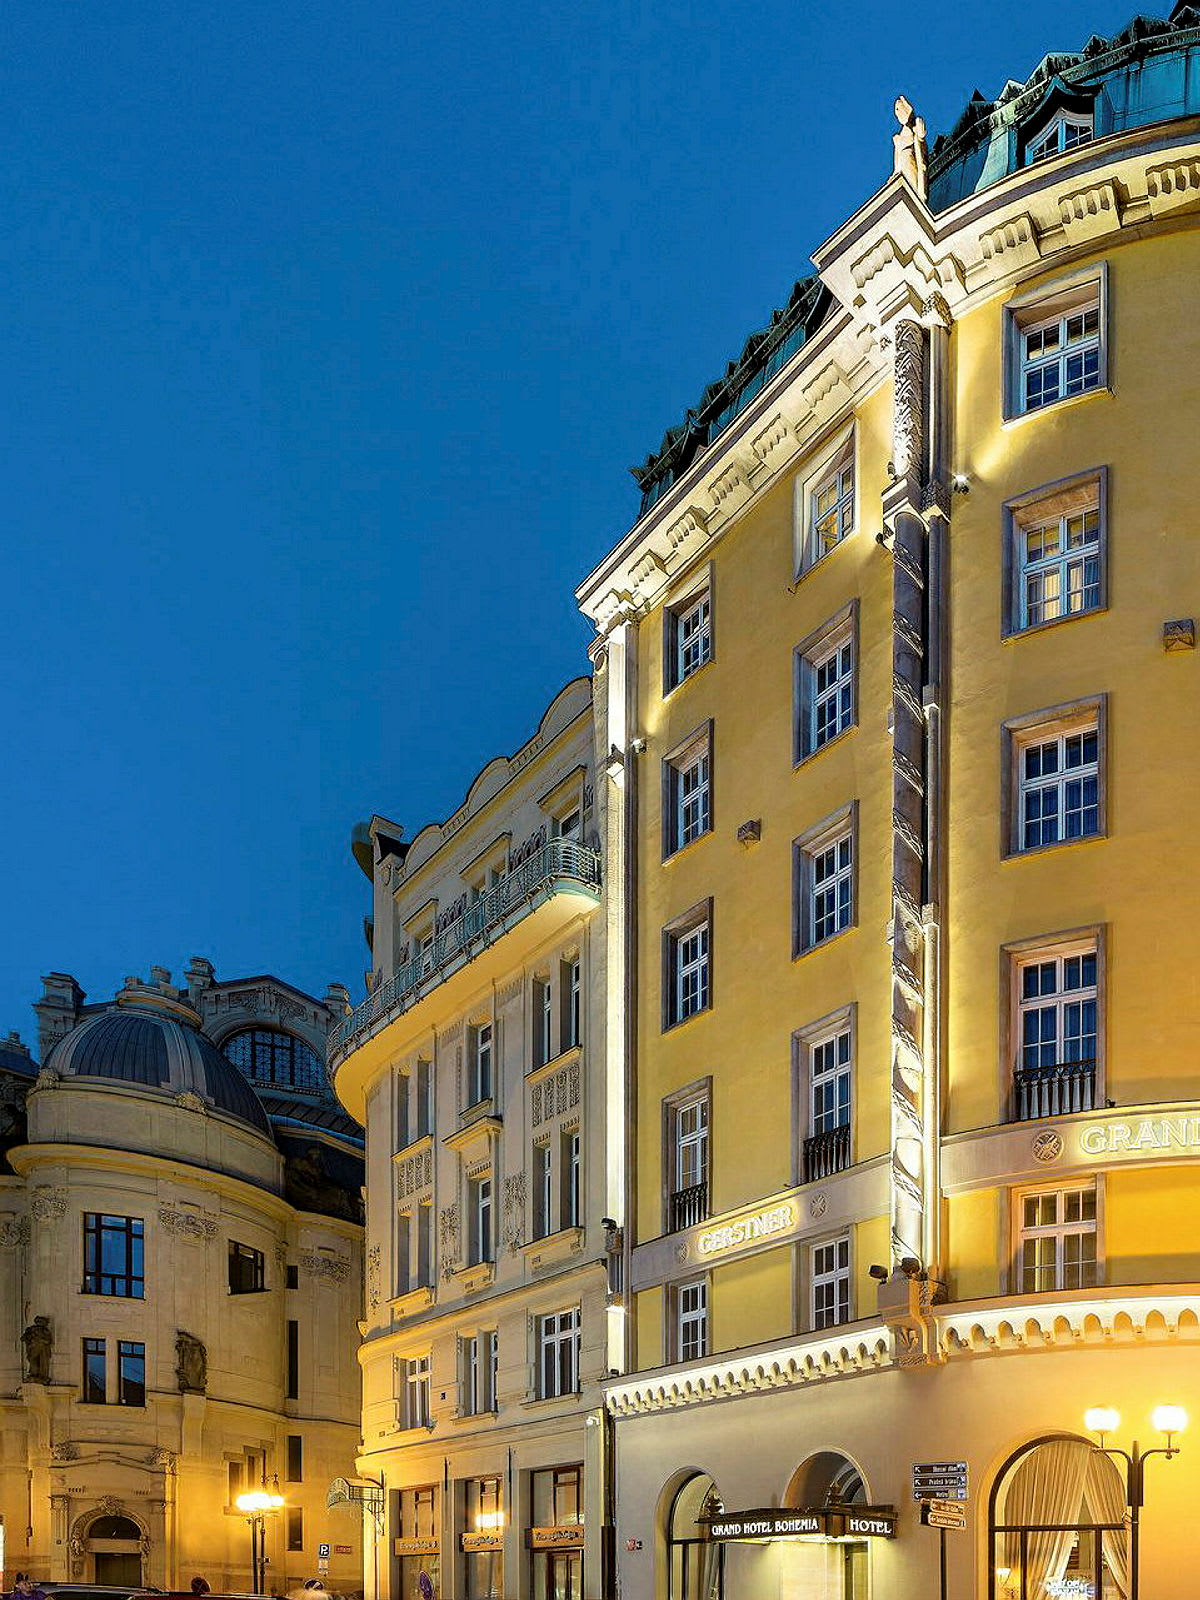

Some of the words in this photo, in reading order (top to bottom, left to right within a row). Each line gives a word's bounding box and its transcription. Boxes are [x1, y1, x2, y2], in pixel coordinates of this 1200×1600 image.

[697, 1205, 793, 1255] GERSTNER
[712, 1524, 740, 1536] GRAND
[743, 1521, 772, 1534] HOTEL
[775, 1518, 819, 1532] BOHEMIA
[850, 1519, 892, 1534] HOTEL
